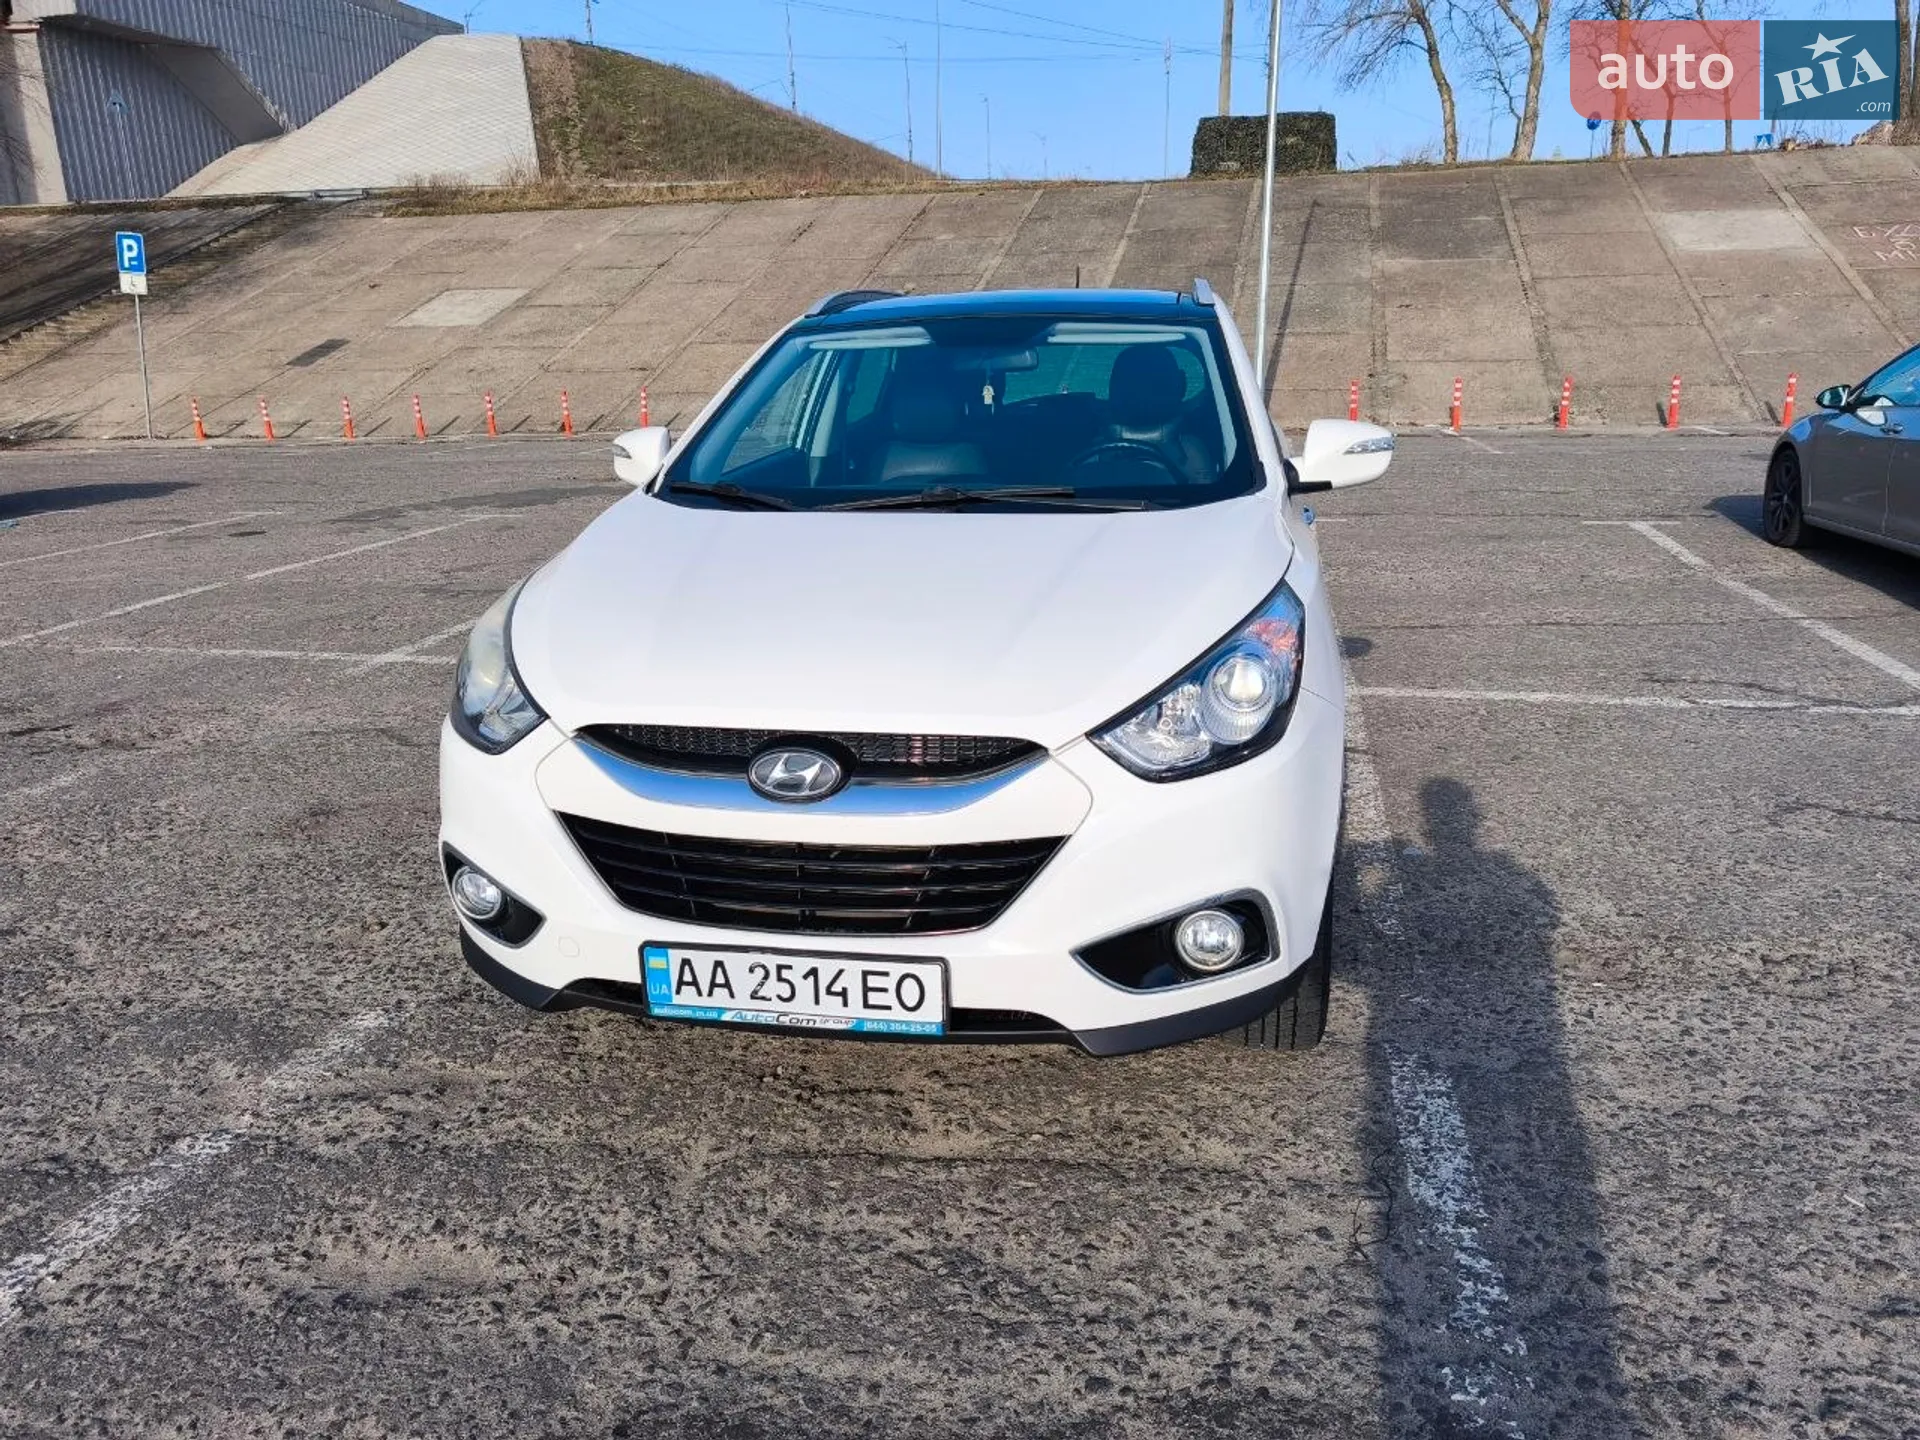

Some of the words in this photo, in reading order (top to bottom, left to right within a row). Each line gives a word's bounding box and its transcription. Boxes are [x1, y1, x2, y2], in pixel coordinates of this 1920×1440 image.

[122, 238, 138, 268] P
[651, 982, 669, 995] UA
[675, 957, 735, 999] AA
[748, 960, 849, 1008] 2514
[861, 969, 926, 1012] EO
[731, 1010, 817, 1026] AutoCom
